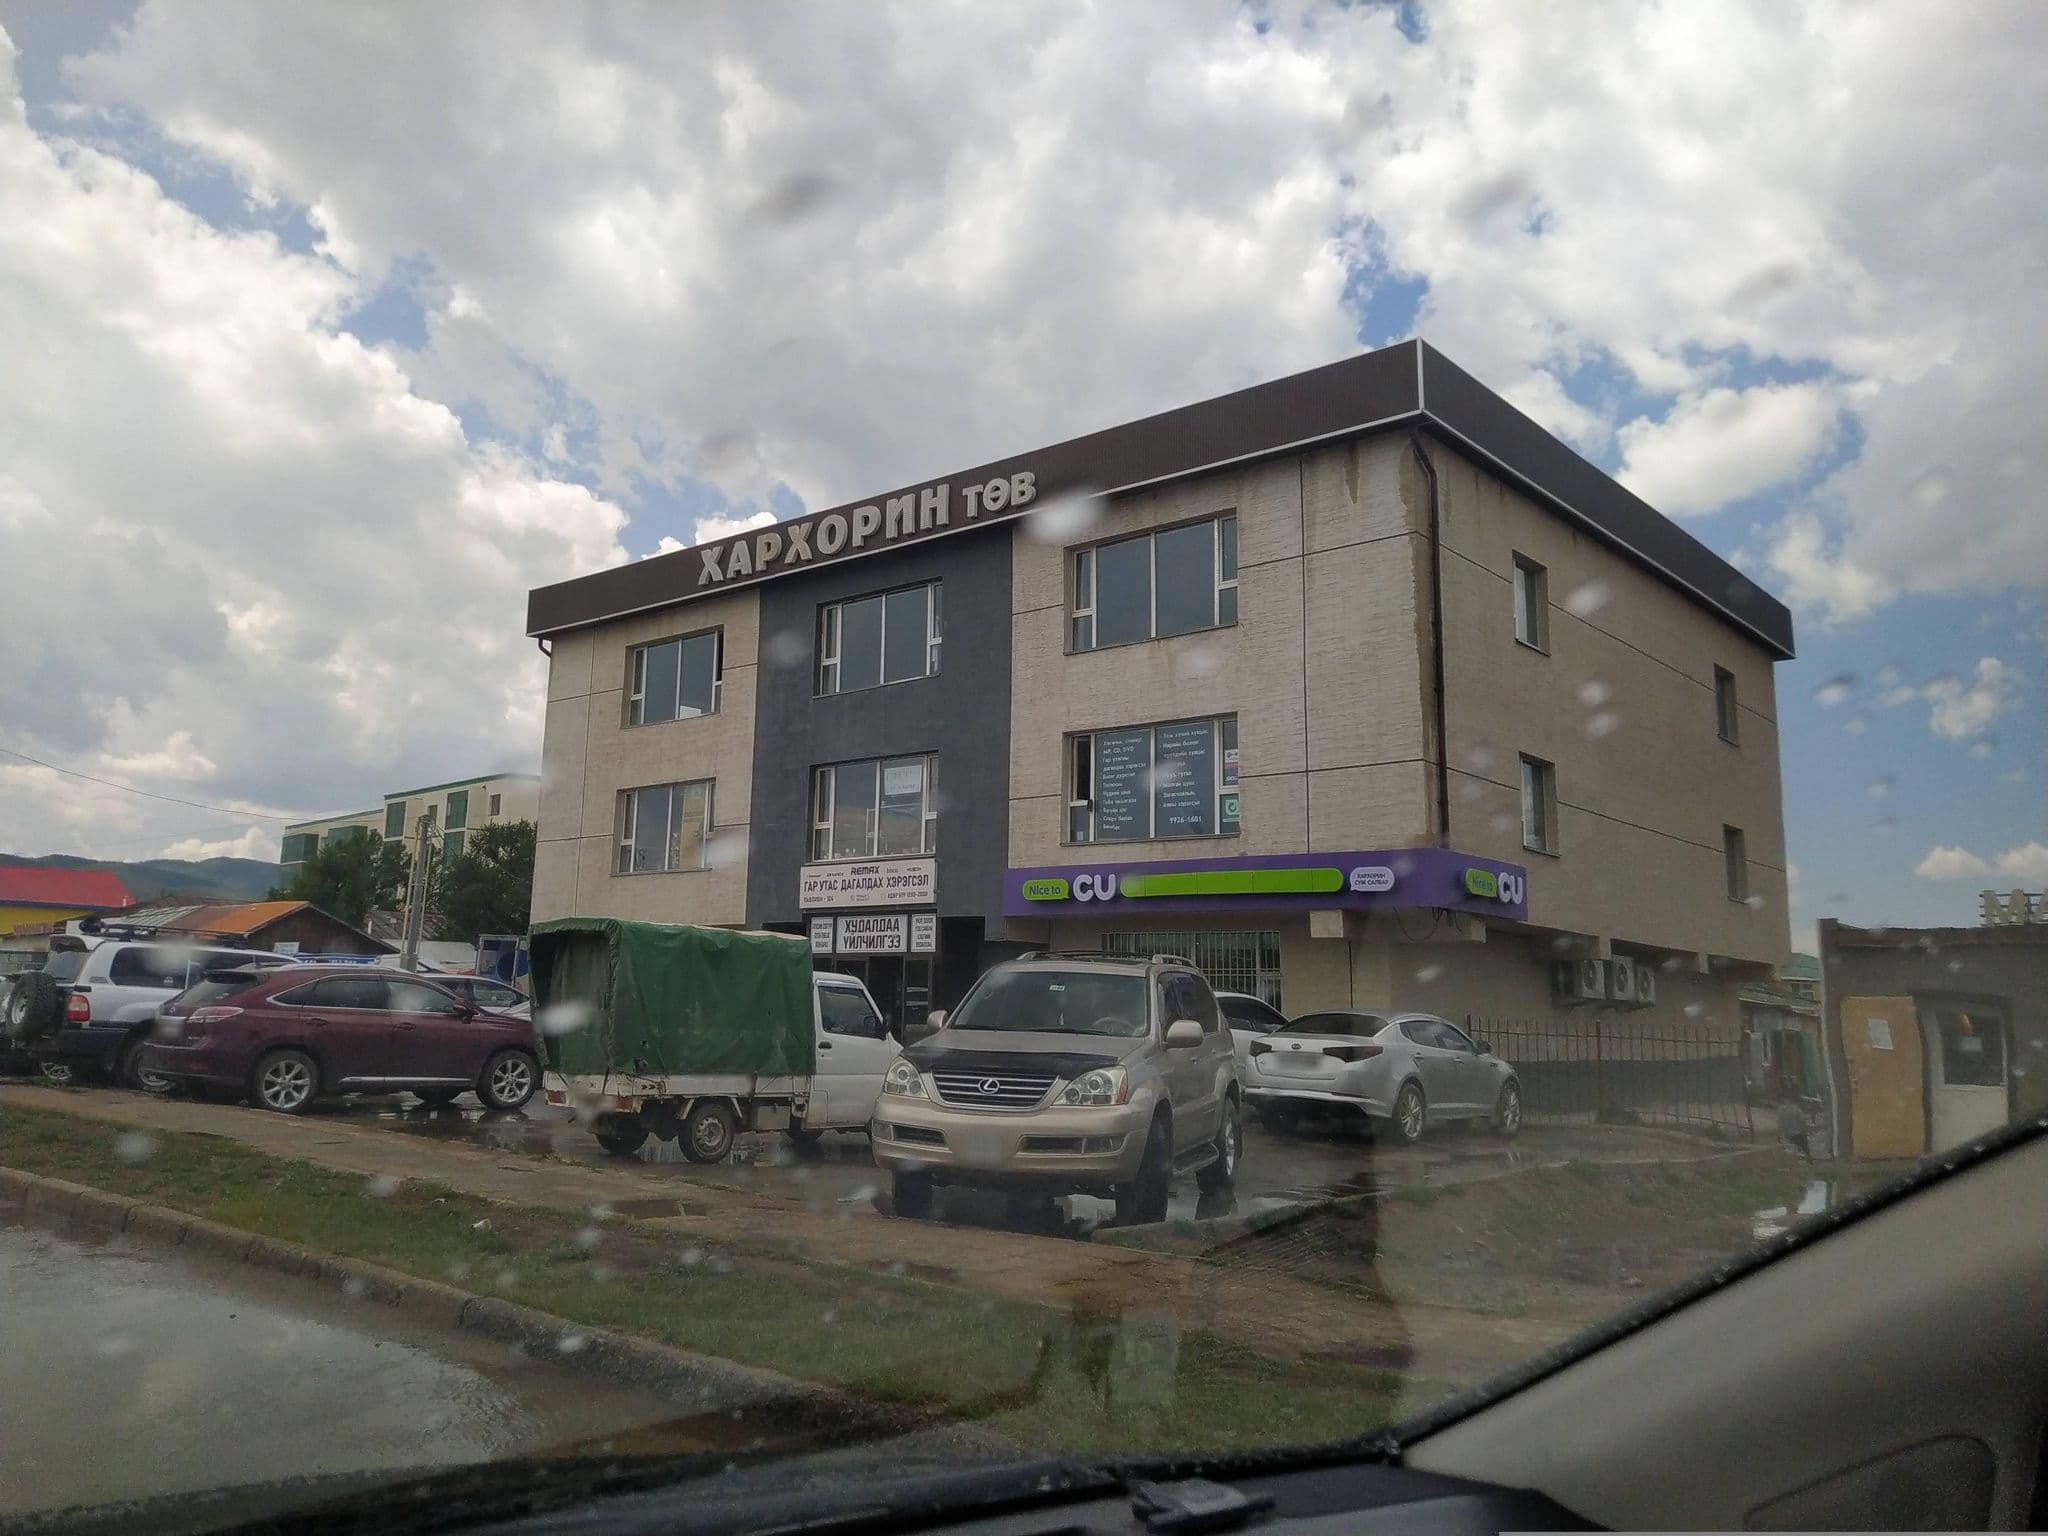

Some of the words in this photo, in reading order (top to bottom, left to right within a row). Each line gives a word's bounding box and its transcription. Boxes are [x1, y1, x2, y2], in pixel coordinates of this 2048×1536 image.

[698, 483, 951, 585] ХАРХОРИН
[962, 471, 1037, 519] ТӨВ
[850, 865, 881, 876] REMAX
[804, 881, 819, 893] ГАР
[819, 879, 839, 891] УТАС
[840, 876, 884, 892] ДАГАЛДАХ
[886, 874, 929, 888] ХЭРЭГСЭЛ
[1029, 884, 1050, 896] Nice
[1051, 884, 1061, 895] to
[1072, 873, 1117, 902] CU
[1498, 872, 1523, 905] CU
[844, 917, 901, 934] ХУДАЛДАА
[843, 933, 902, 950] ҮЙЛЧИЛГЭЭ
